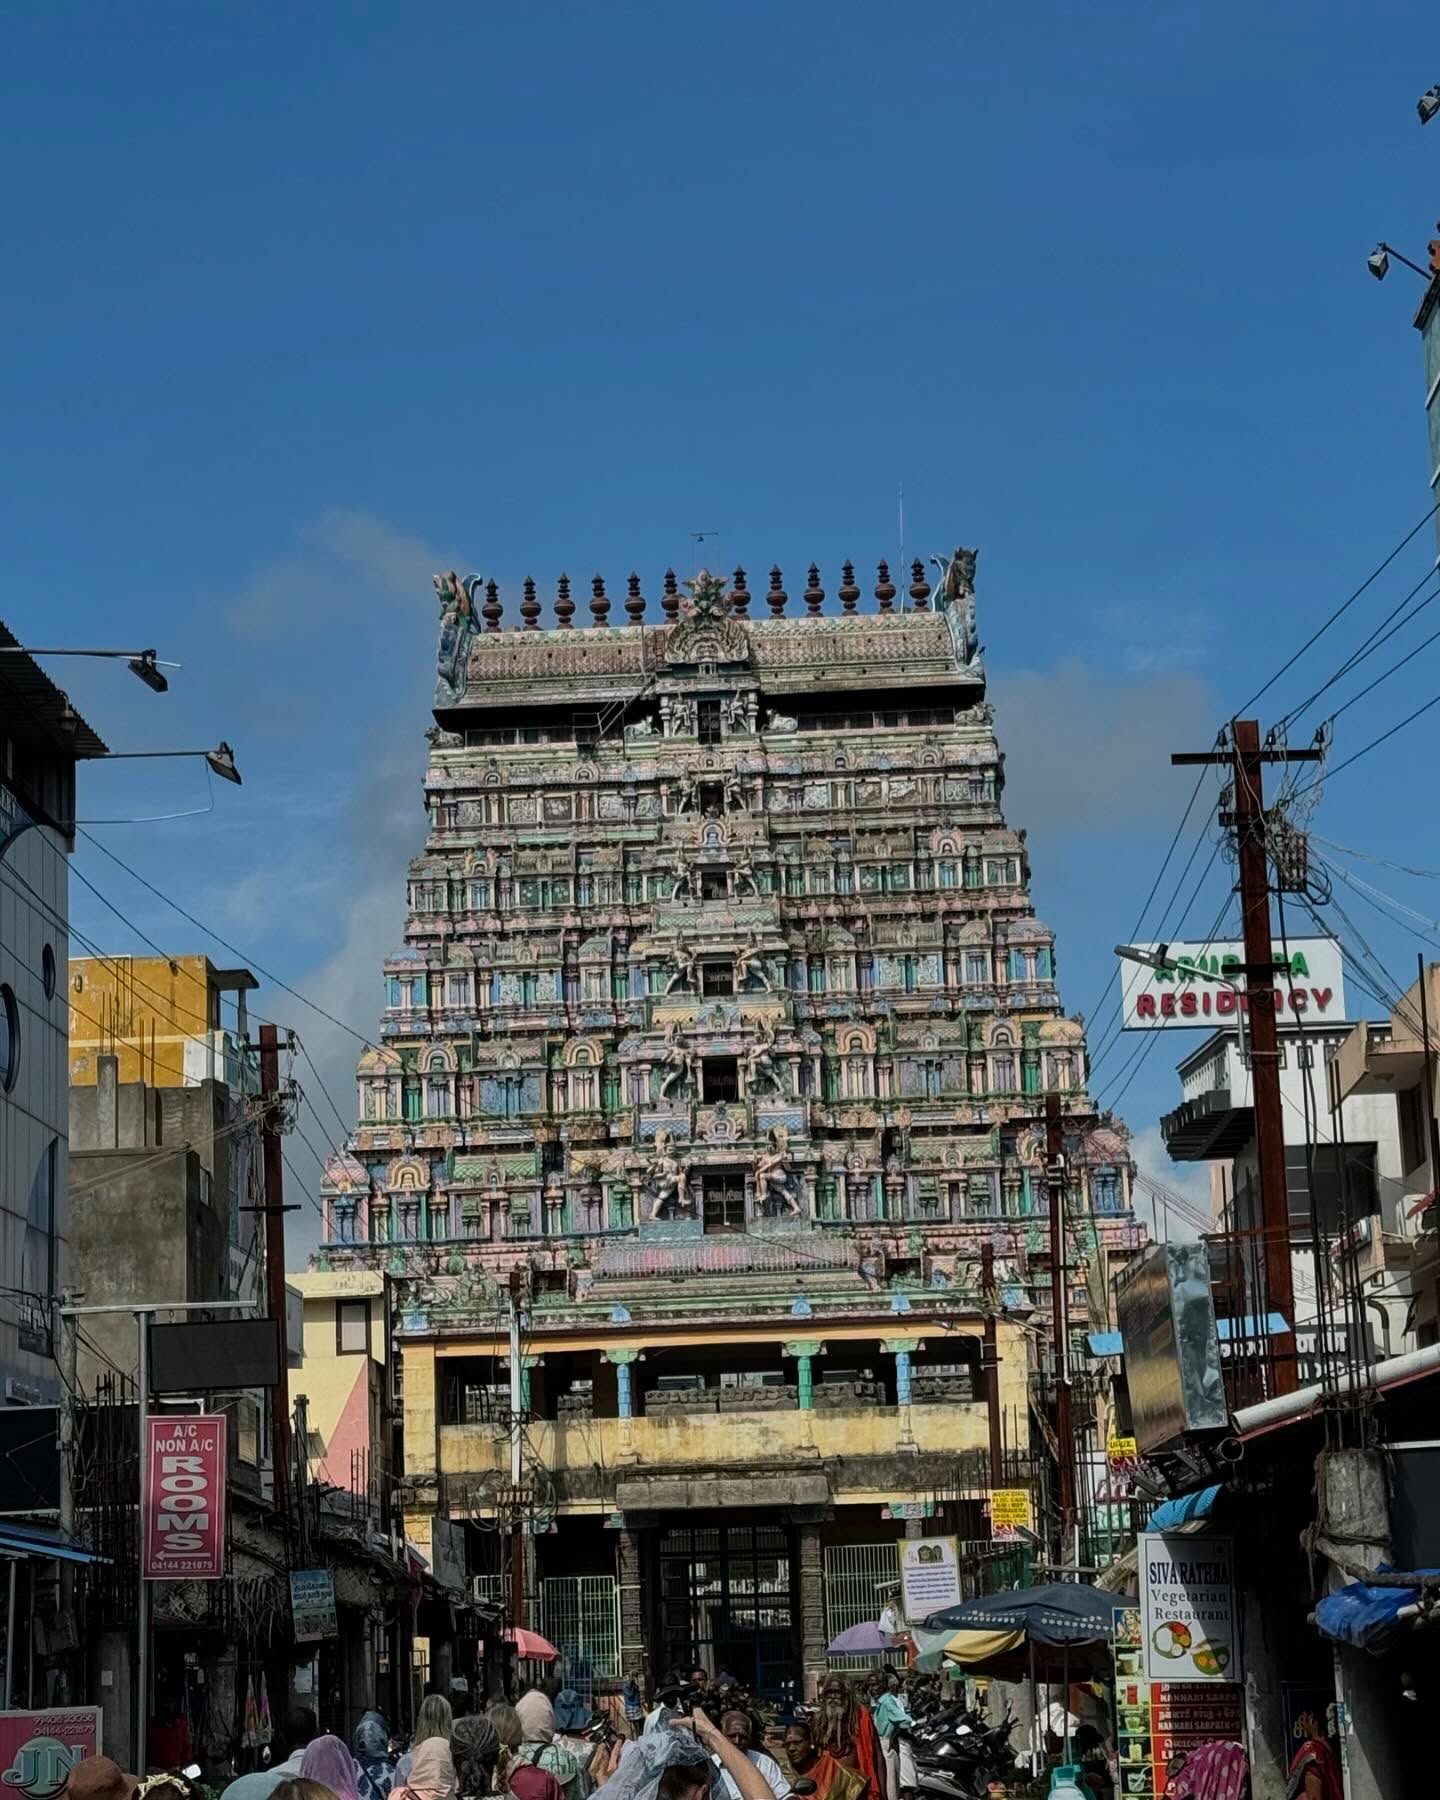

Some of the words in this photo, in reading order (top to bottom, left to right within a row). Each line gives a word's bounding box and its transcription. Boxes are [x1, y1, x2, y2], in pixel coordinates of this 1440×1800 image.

[1155, 953, 1309, 983] ARUDRA
[1136, 987, 1333, 1017] RESIDCY
[172, 1424, 198, 1438] A/C
[155, 1439, 186, 1453] NON
[189, 1439, 214, 1452] A/C
[157, 1455, 209, 1551] ROOMS
[1150, 1589, 1228, 1607] Vegetarian
[1154, 1606, 1231, 1622] Restaurant
